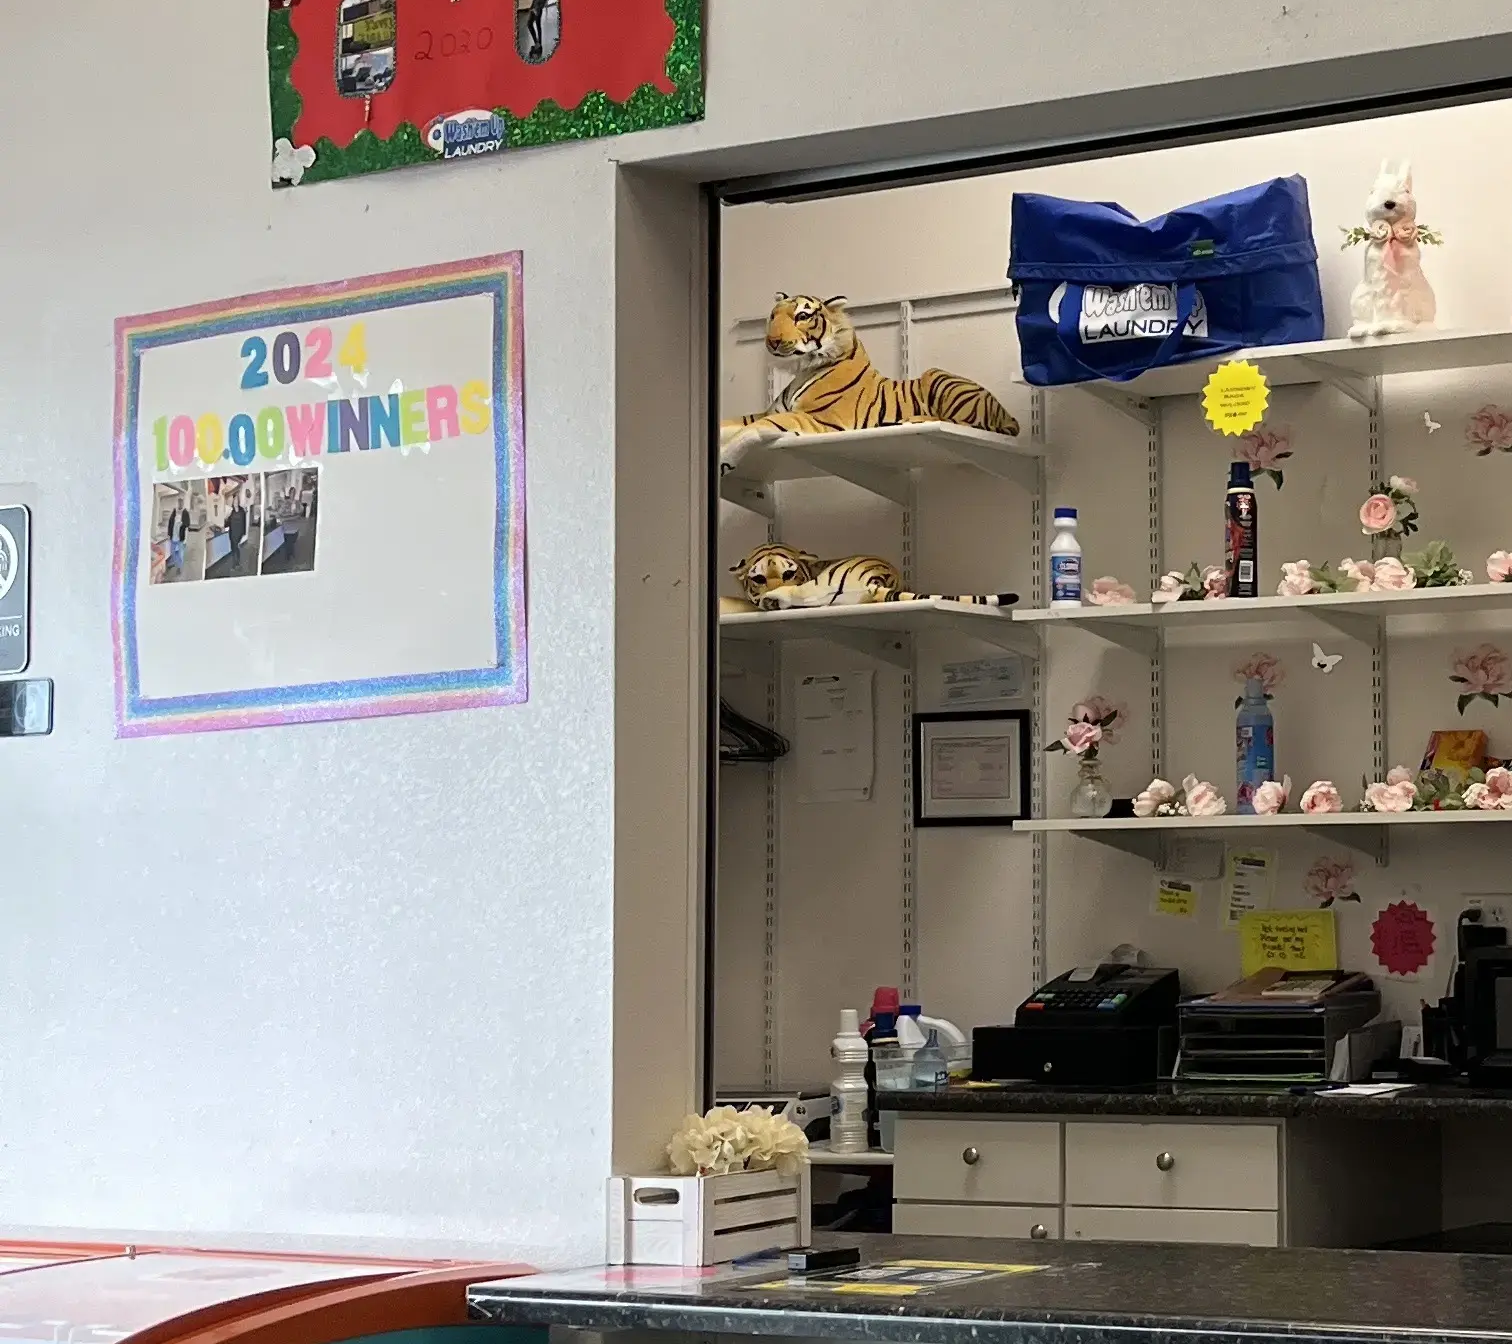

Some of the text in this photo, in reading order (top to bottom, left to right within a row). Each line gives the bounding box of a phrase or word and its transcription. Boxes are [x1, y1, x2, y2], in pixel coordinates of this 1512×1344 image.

[490, 114, 505, 139] Up
[445, 139, 503, 158] LAUNDRY
[240, 322, 368, 389] 2024
